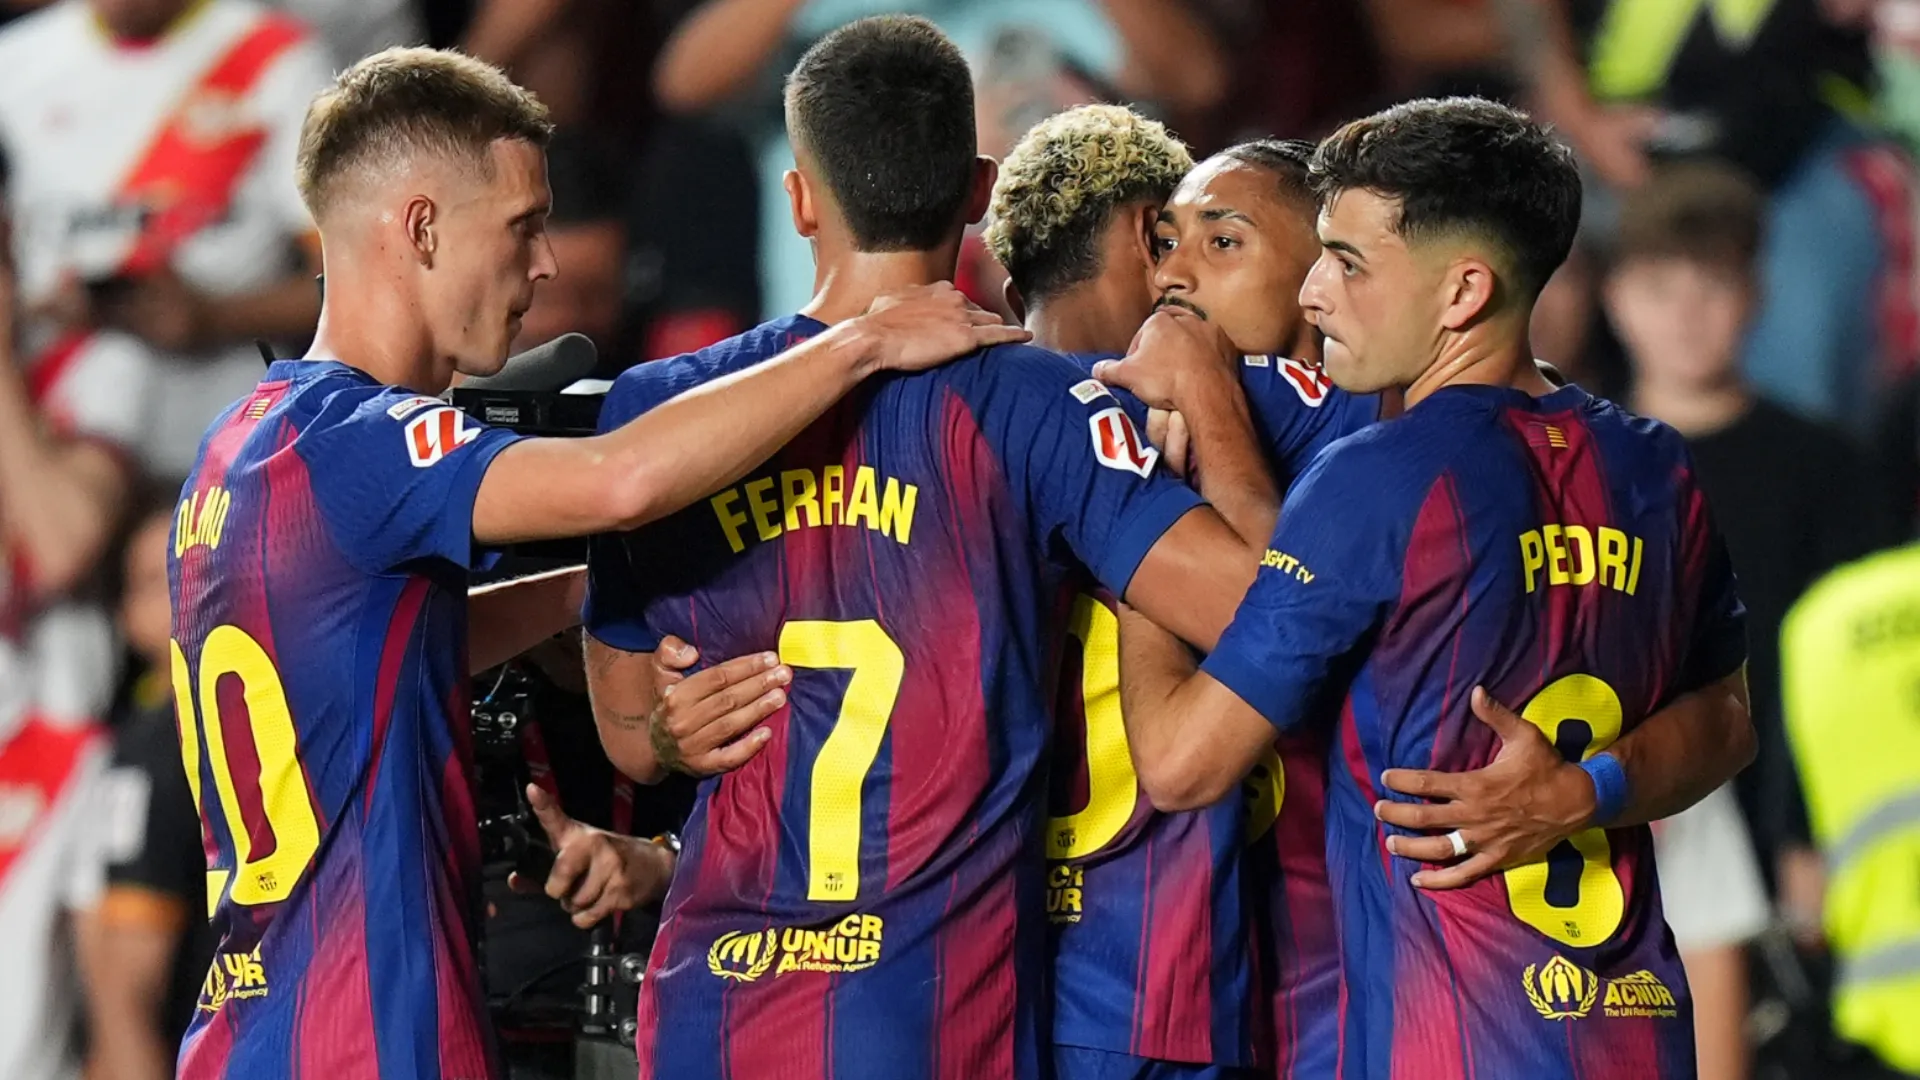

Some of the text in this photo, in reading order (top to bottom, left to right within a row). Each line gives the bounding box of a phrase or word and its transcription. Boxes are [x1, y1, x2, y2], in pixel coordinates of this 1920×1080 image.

[175, 486, 230, 558] OLMO
[710, 465, 918, 553] FERRAN
[1296, 565, 1315, 584] tv
[1519, 524, 1643, 596] PEDRI
[778, 619, 904, 900] 7
[1603, 983, 1676, 1006] ACNUR
